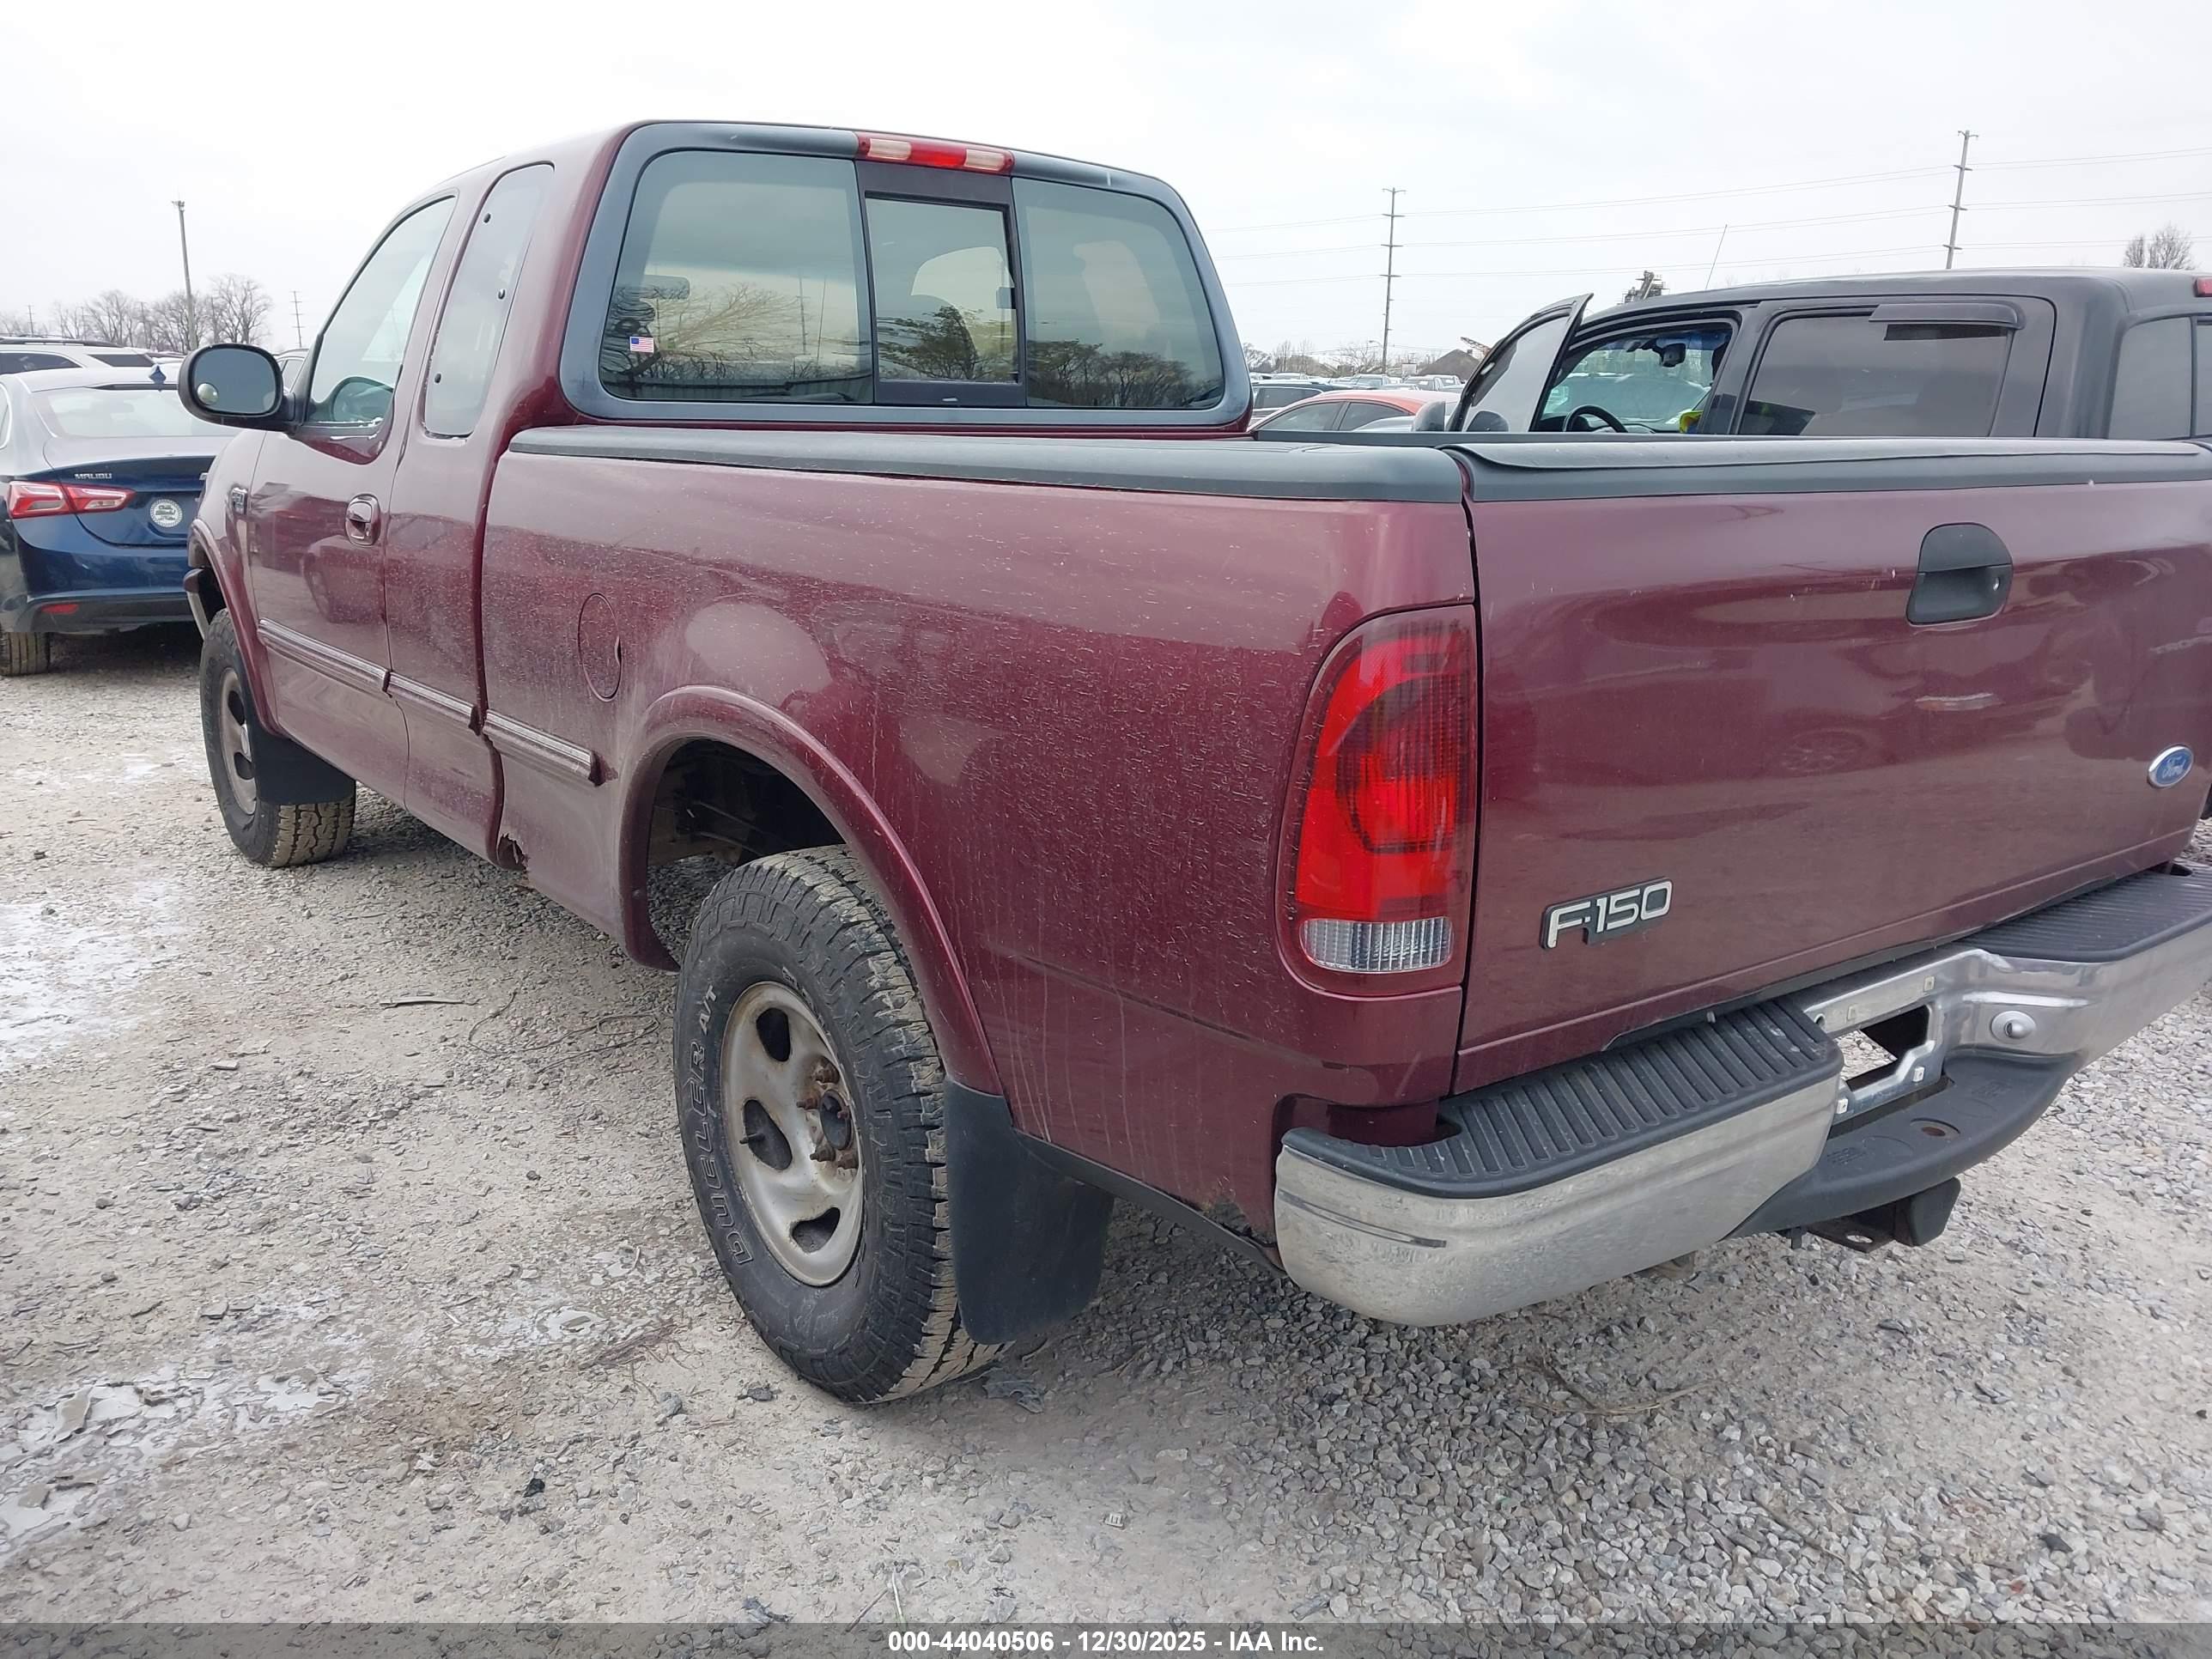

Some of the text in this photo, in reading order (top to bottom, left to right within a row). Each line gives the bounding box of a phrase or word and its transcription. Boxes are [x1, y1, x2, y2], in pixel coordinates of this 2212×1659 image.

[1546, 880, 1674, 949] F-150
[689, 985, 754, 1267] DUELER A/T
